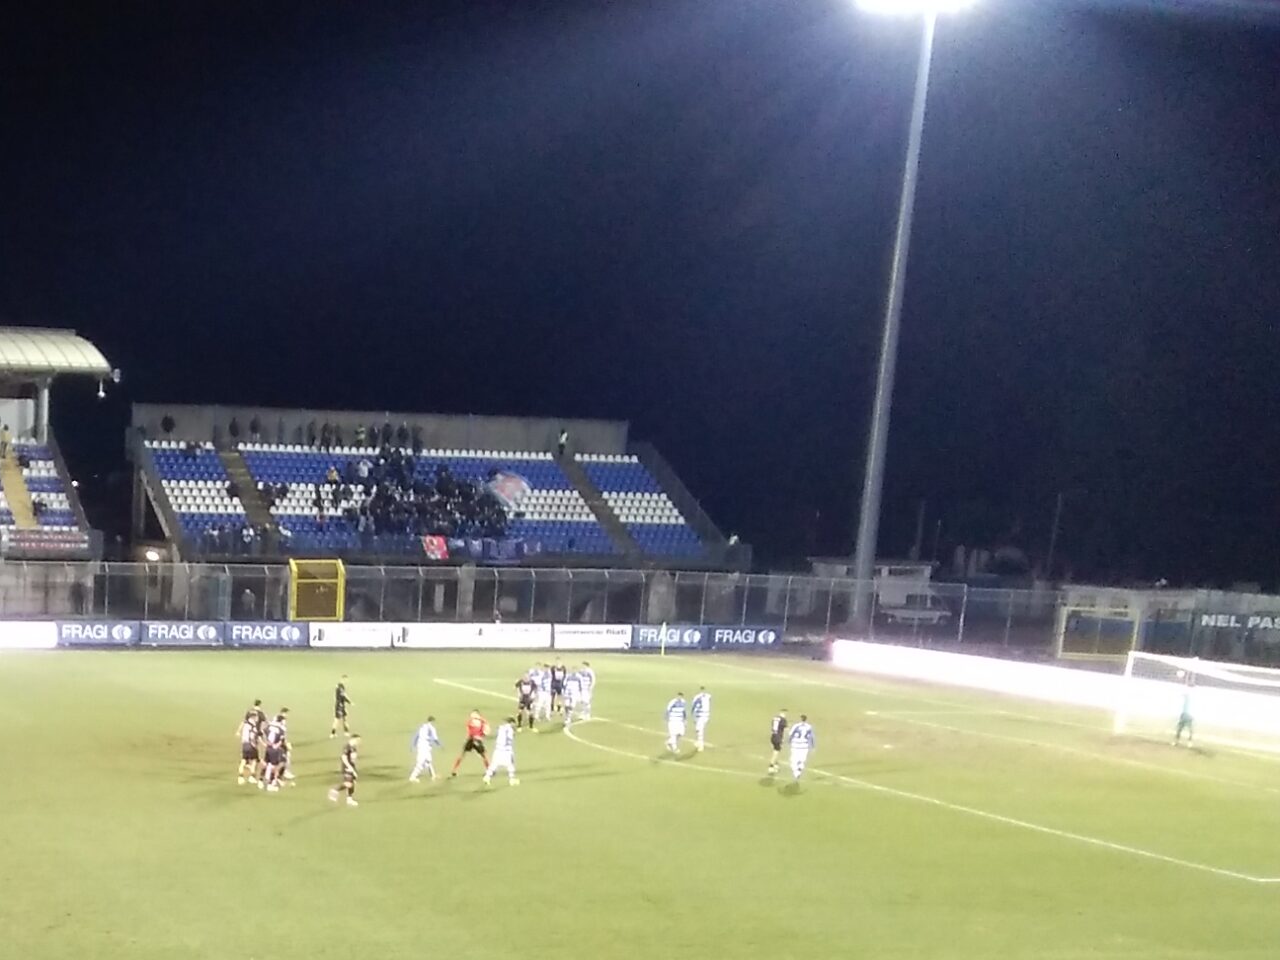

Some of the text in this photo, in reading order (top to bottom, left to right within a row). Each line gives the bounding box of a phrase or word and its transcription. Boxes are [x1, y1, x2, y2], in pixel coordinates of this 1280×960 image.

[1201, 614, 1242, 628] NEL
[61, 624, 108, 640] FRAGI
[148, 624, 194, 640] FRAGI
[232, 624, 278, 640] FRAGI
[639, 628, 680, 643] FRAGI
[714, 628, 756, 644] FRAGI
